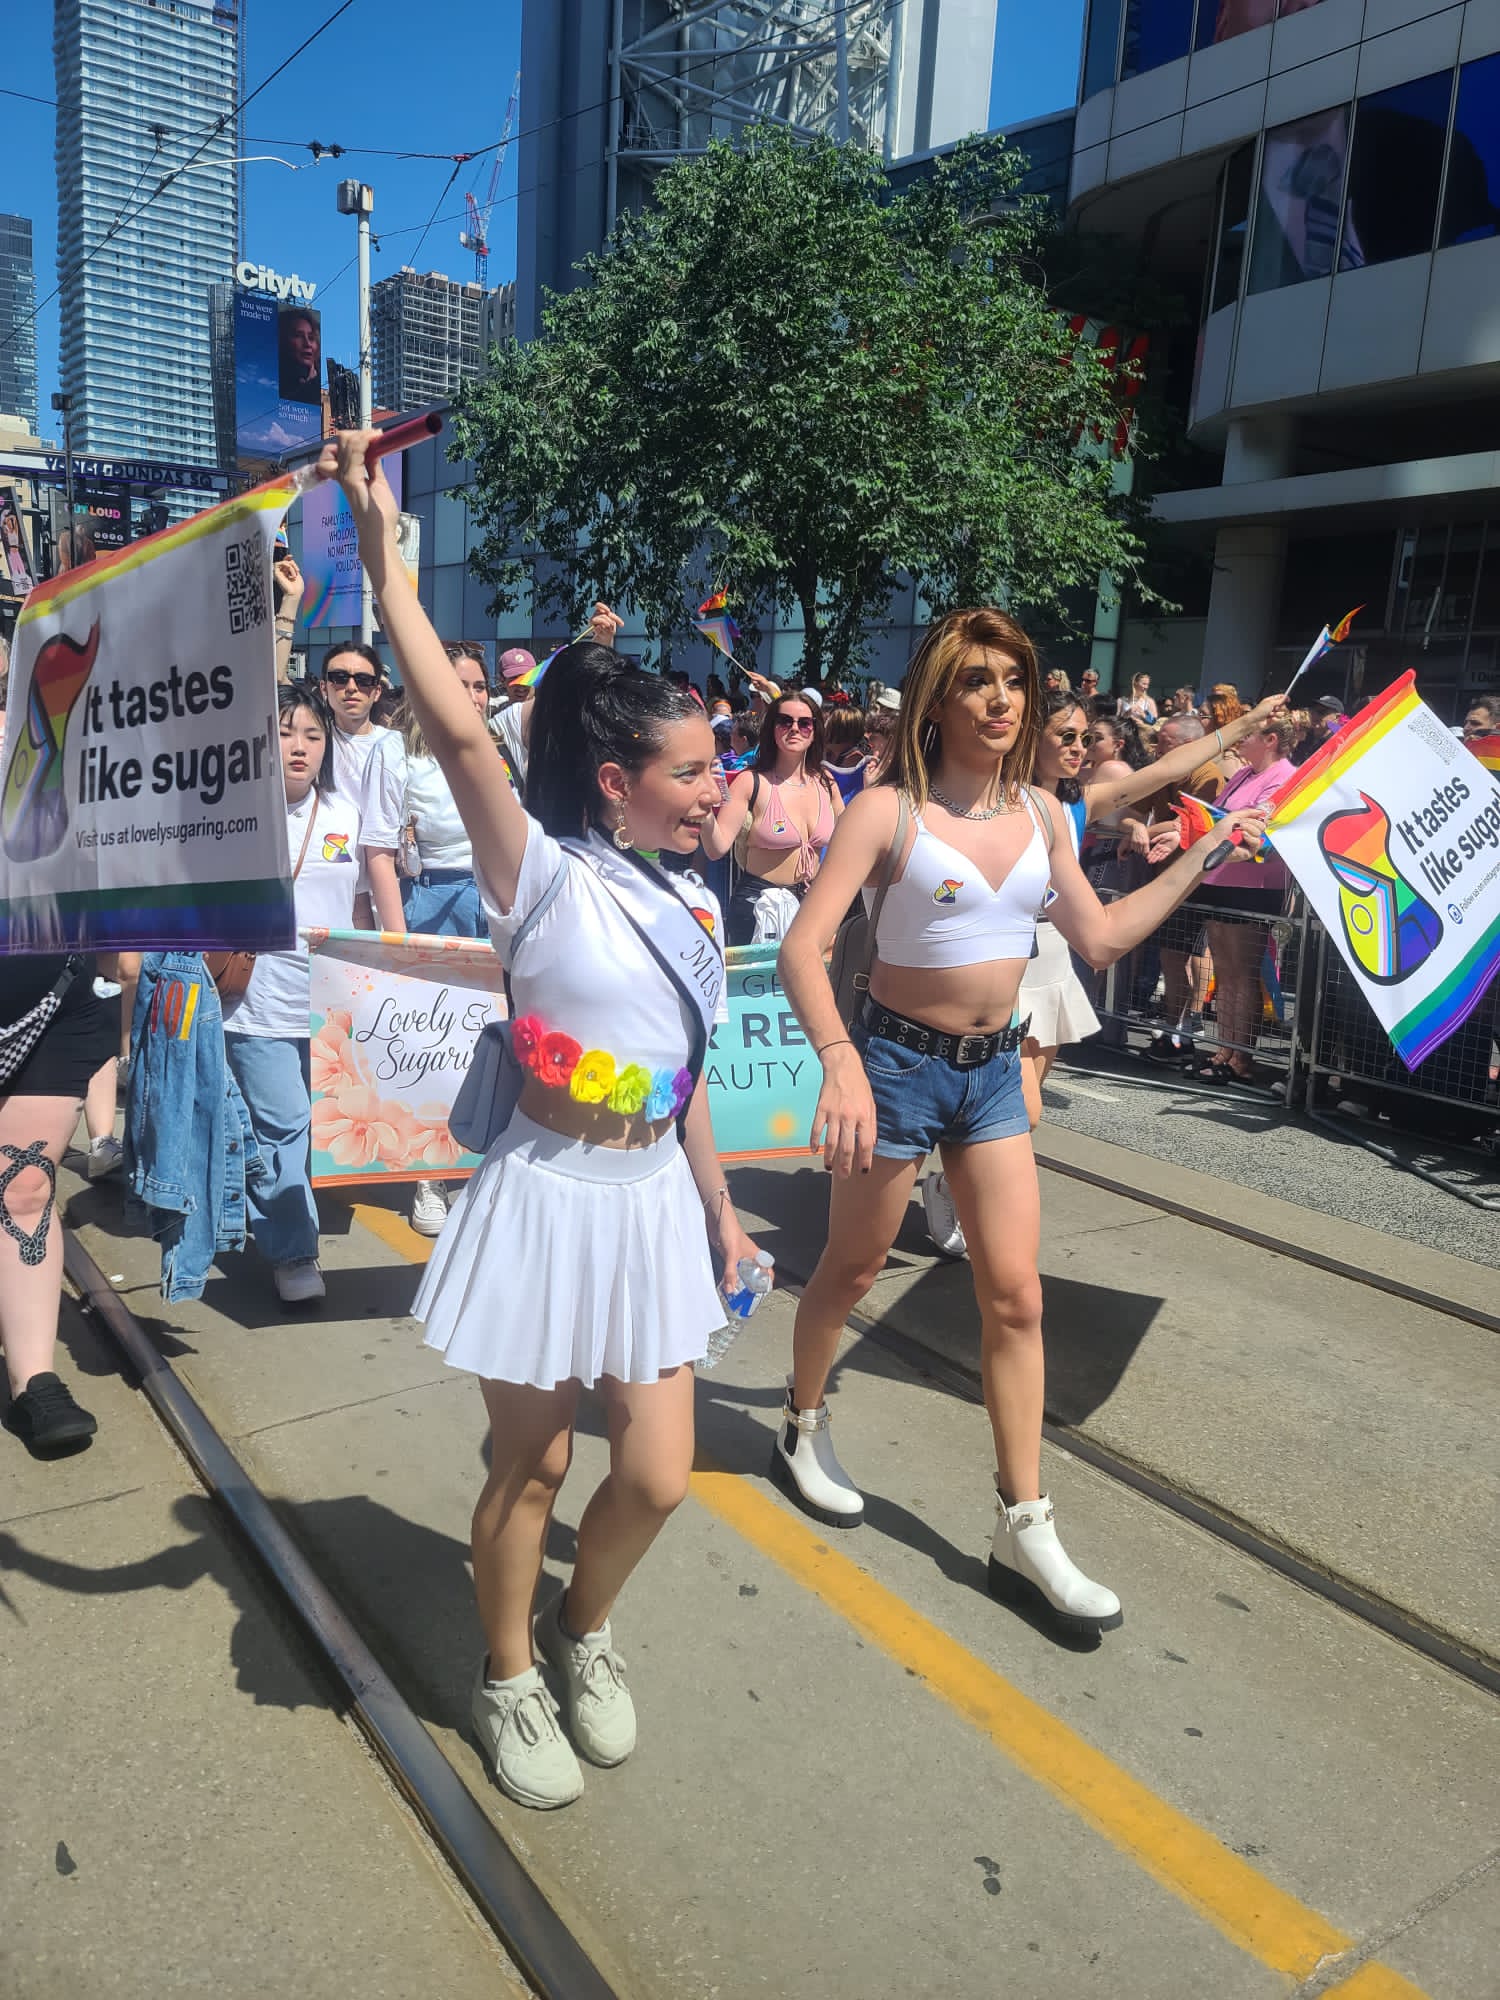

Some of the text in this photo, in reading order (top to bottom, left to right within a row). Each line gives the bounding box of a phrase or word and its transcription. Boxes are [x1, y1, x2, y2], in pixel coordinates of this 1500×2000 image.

[236, 261, 317, 300] Citytv
[89, 505, 121, 519] LOUD
[322, 512, 340, 528] FAMILY
[342, 527, 356, 540] LOVE
[82, 665, 234, 736] It tastes
[79, 713, 275, 805] like sugar!
[76, 816, 258, 848] Visit us at lovelysugaring.com
[1396, 776, 1470, 855] It tastes
[1420, 848, 1463, 896] like
[680, 939, 721, 1009] Miss
[356, 988, 492, 1050] Lovely &
[376, 1039, 475, 1089] Sugari
[707, 1060, 804, 1091] AUTY
